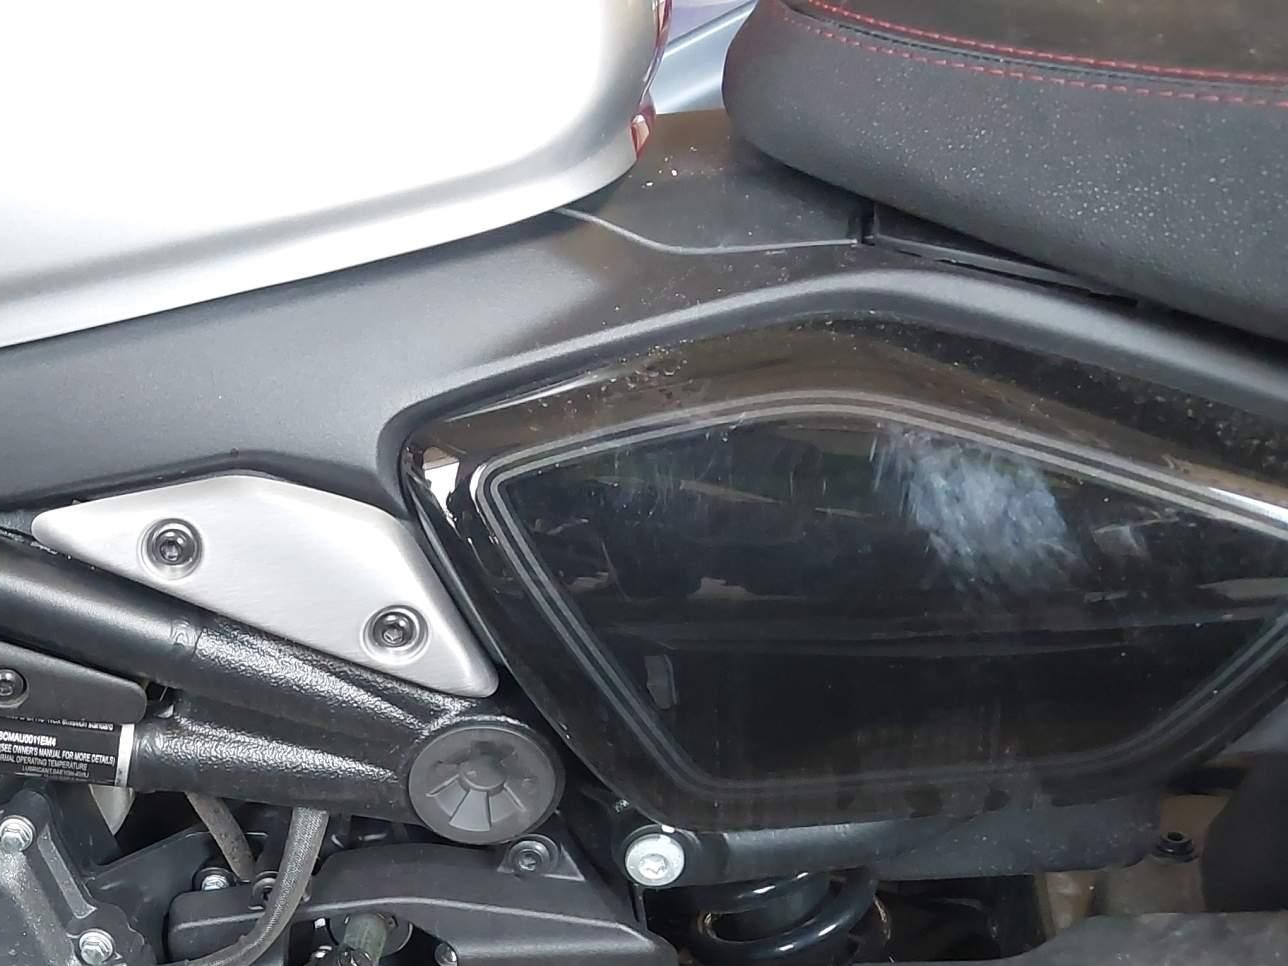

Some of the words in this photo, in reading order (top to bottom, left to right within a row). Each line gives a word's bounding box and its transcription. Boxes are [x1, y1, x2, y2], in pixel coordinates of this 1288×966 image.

[12, 744, 38, 755] OWNER'S
[38, 748, 61, 759] MANUAL
[62, 750, 73, 760] FOR
[74, 752, 91, 762] MORE
[16, 756, 47, 767] OPERATING
[47, 759, 88, 771] TEMPERATURE
